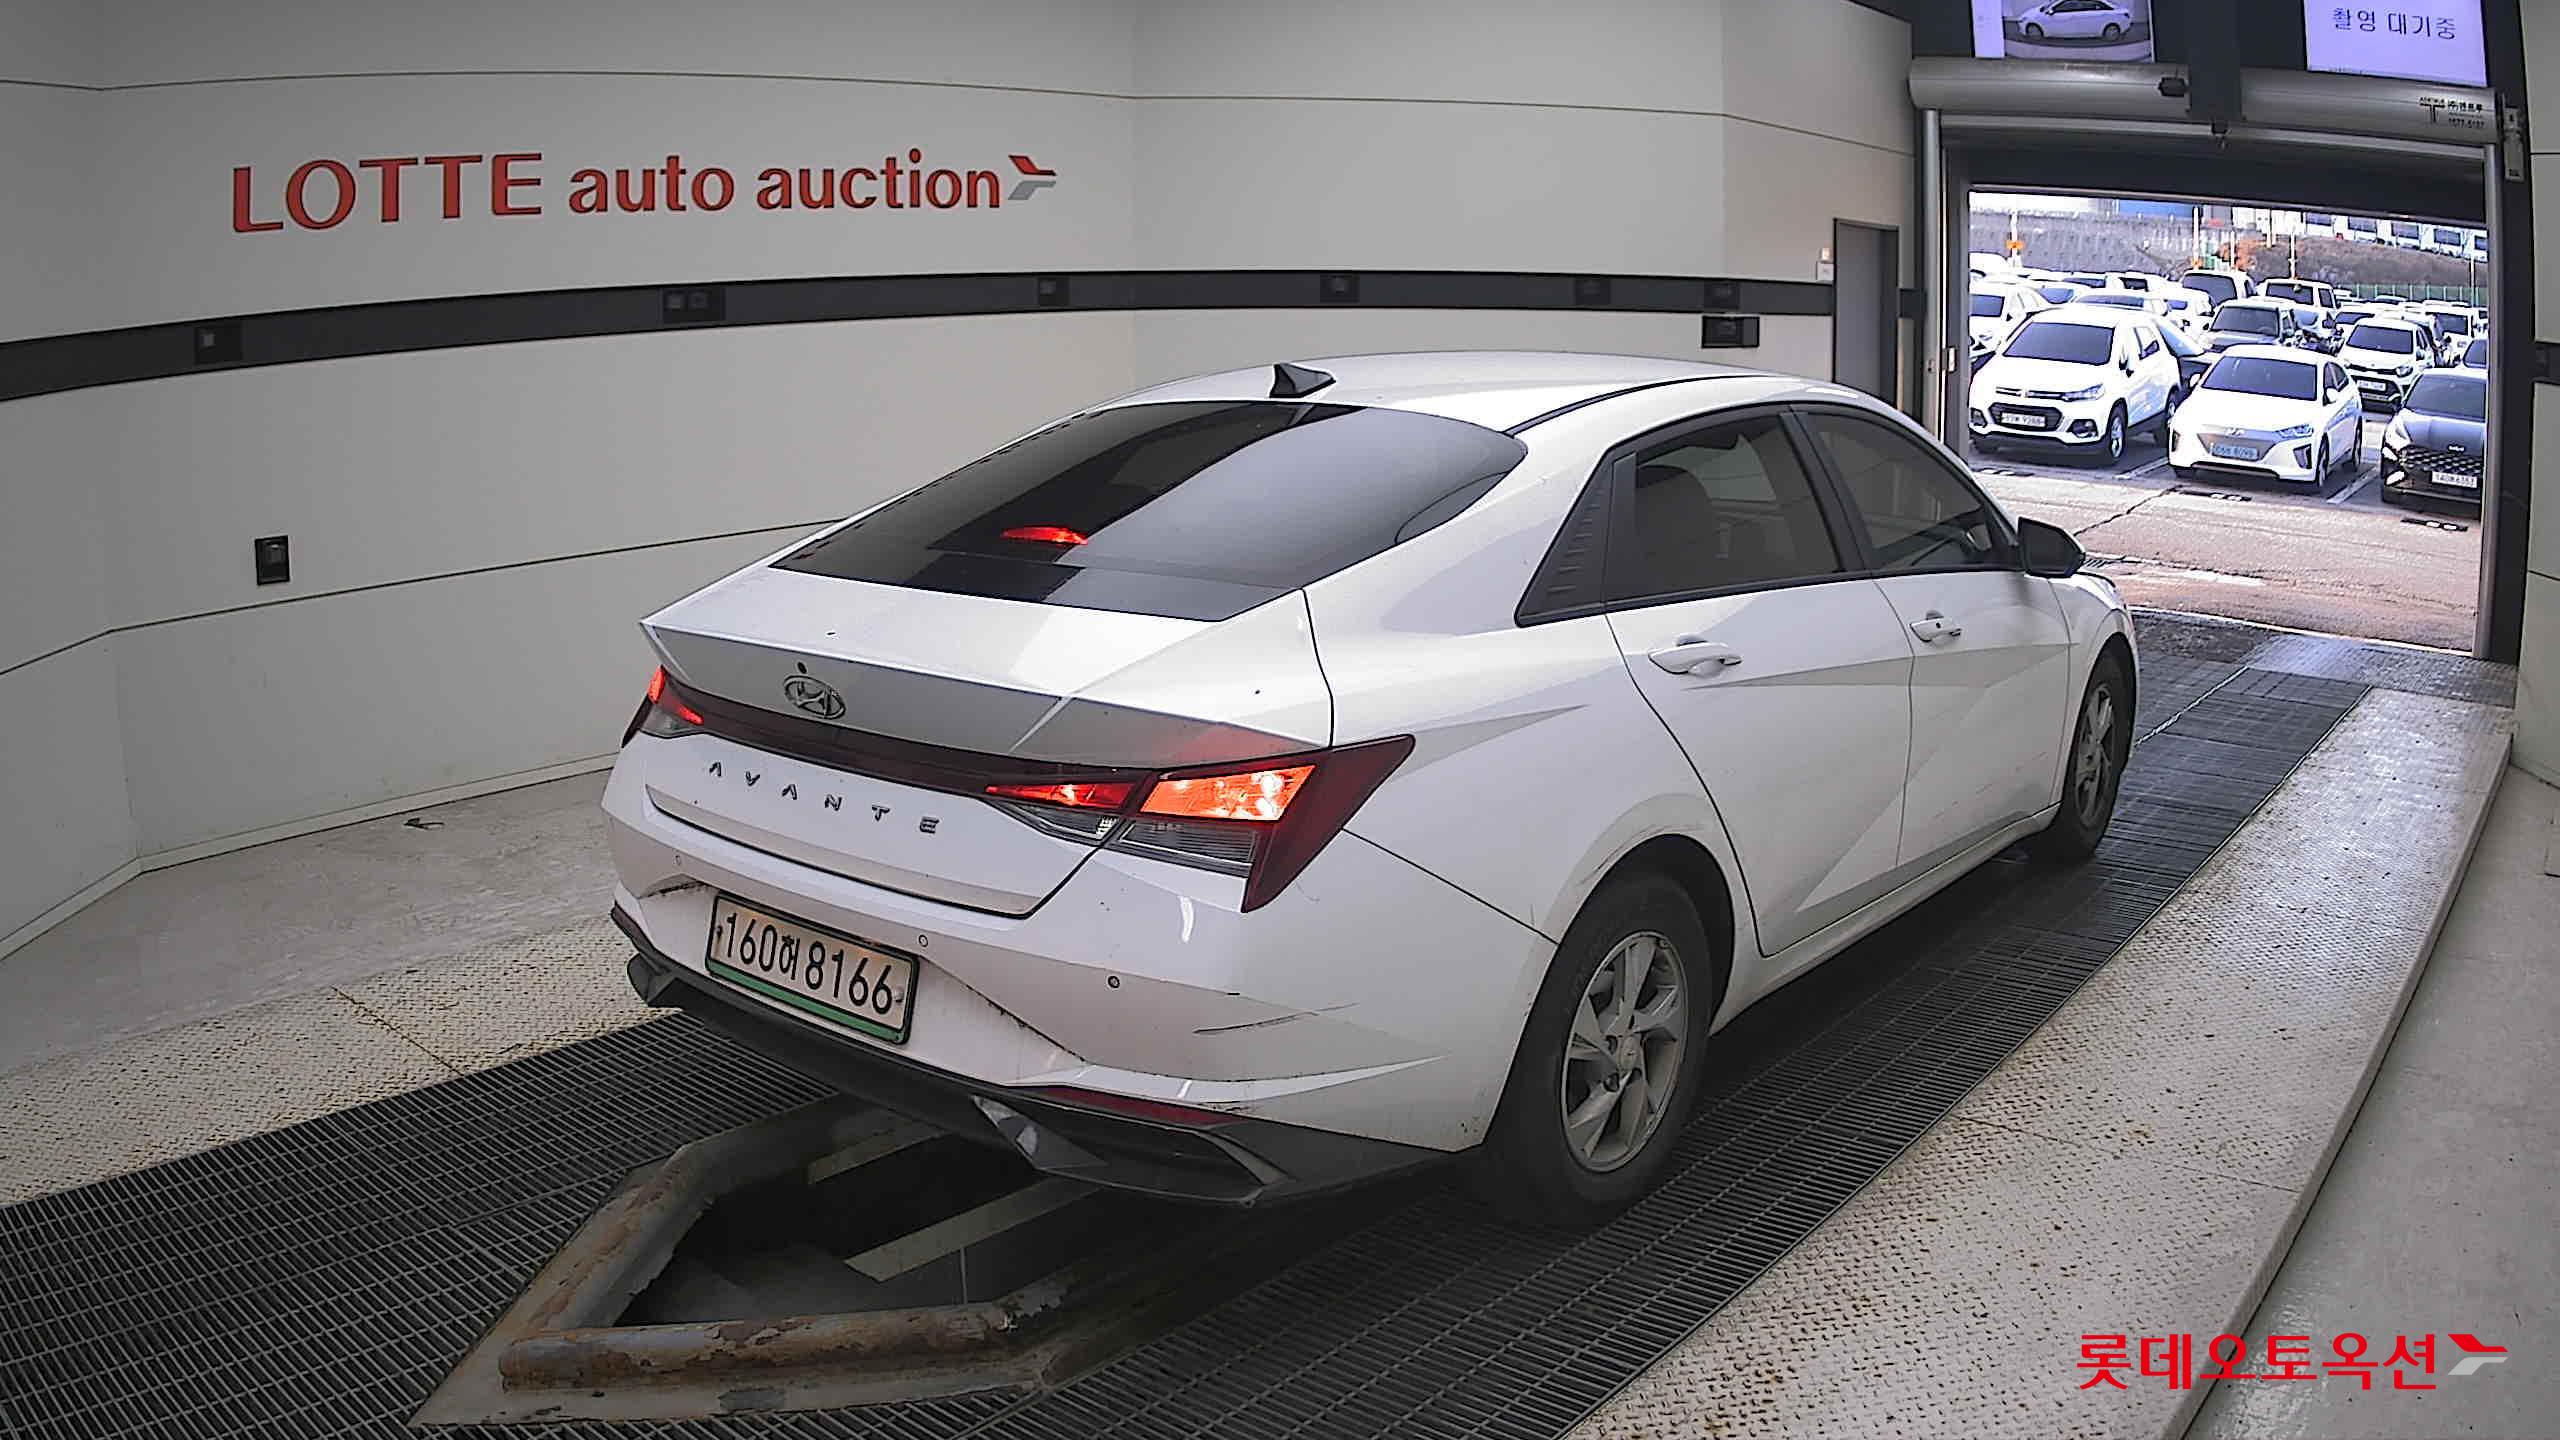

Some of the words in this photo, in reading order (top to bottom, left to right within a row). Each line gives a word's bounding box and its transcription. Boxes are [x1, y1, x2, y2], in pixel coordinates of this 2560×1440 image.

[2333, 7, 2376, 32] 촬영
[2388, 12, 2456, 40] 대기중
[232, 152, 543, 233] LOTTE
[568, 155, 735, 213] auto
[756, 149, 1001, 209] auction
[708, 761, 940, 834] AVANTE
[726, 912, 893, 1015] 160허8166
